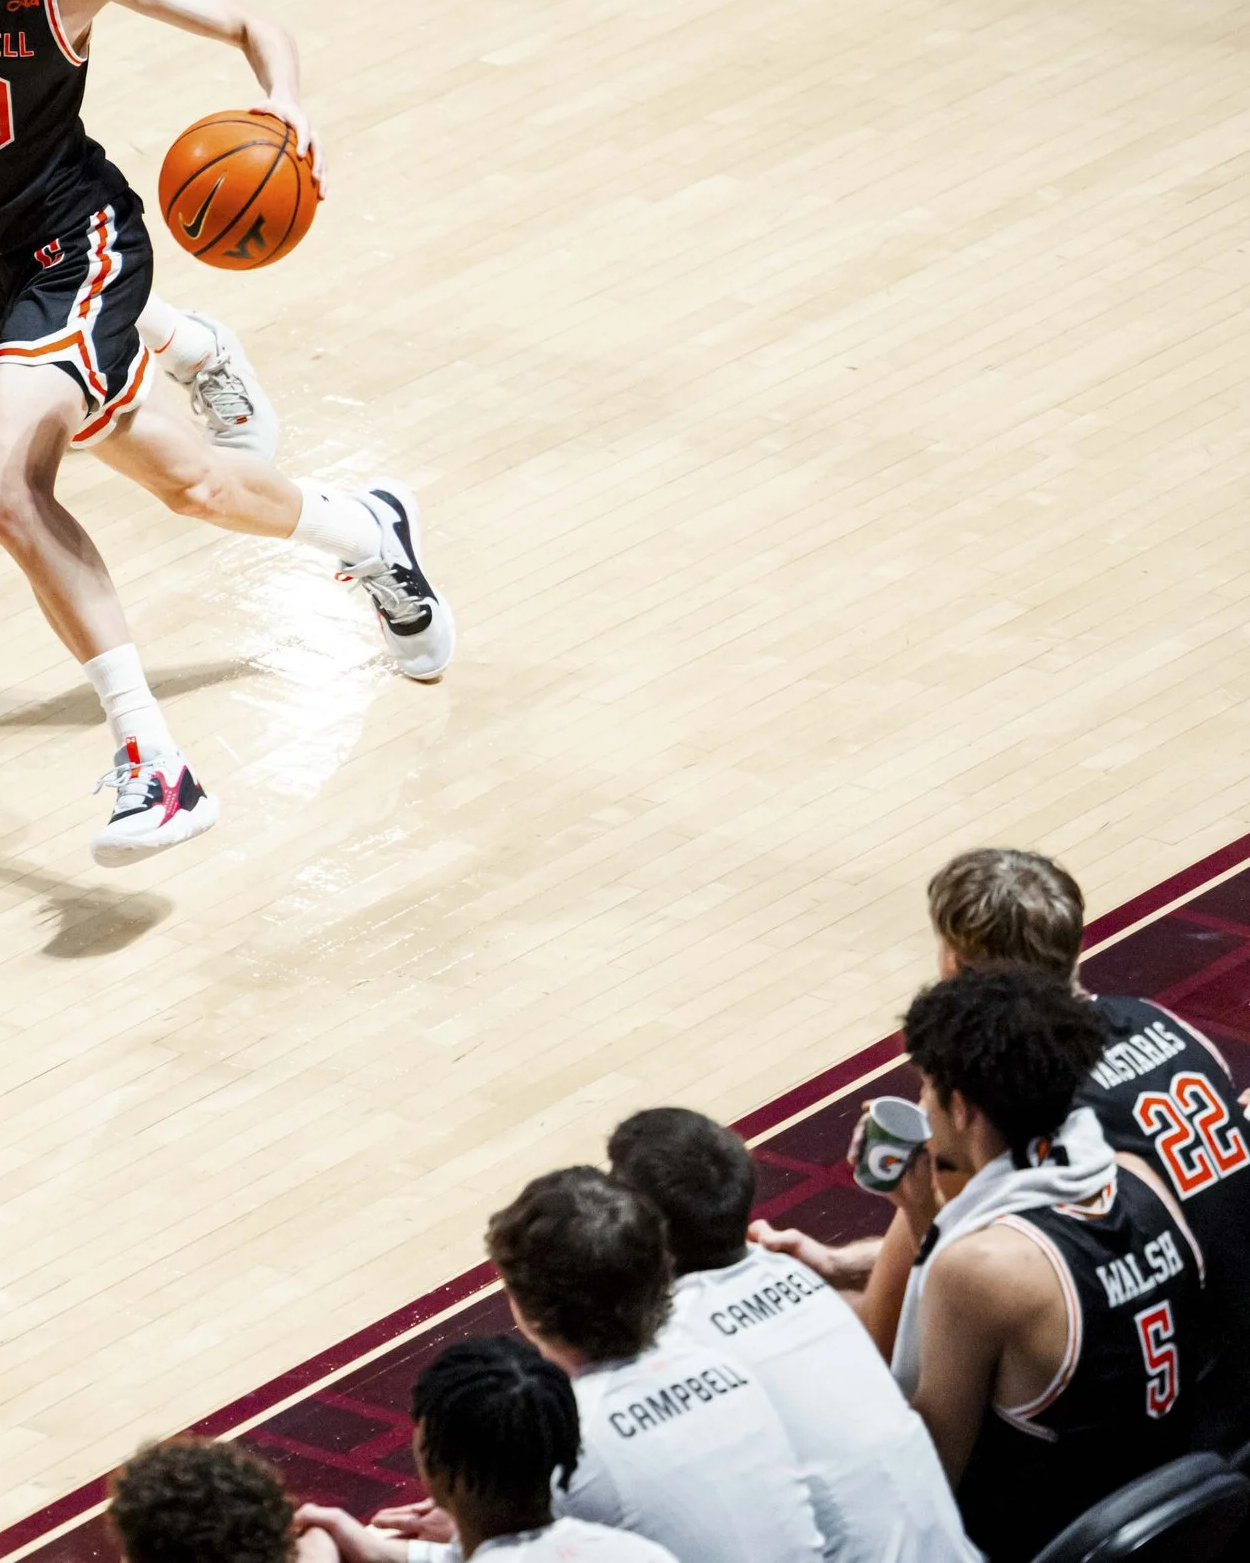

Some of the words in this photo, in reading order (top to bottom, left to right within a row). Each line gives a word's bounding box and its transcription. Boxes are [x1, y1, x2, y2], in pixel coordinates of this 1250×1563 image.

[1132, 1070, 1250, 1201] 22
[709, 1271, 828, 1337] CAMPBEL
[1095, 1229, 1185, 1309] WALSH
[1134, 1299, 1180, 1420] 5
[607, 1364, 749, 1439] CAMPBELL
